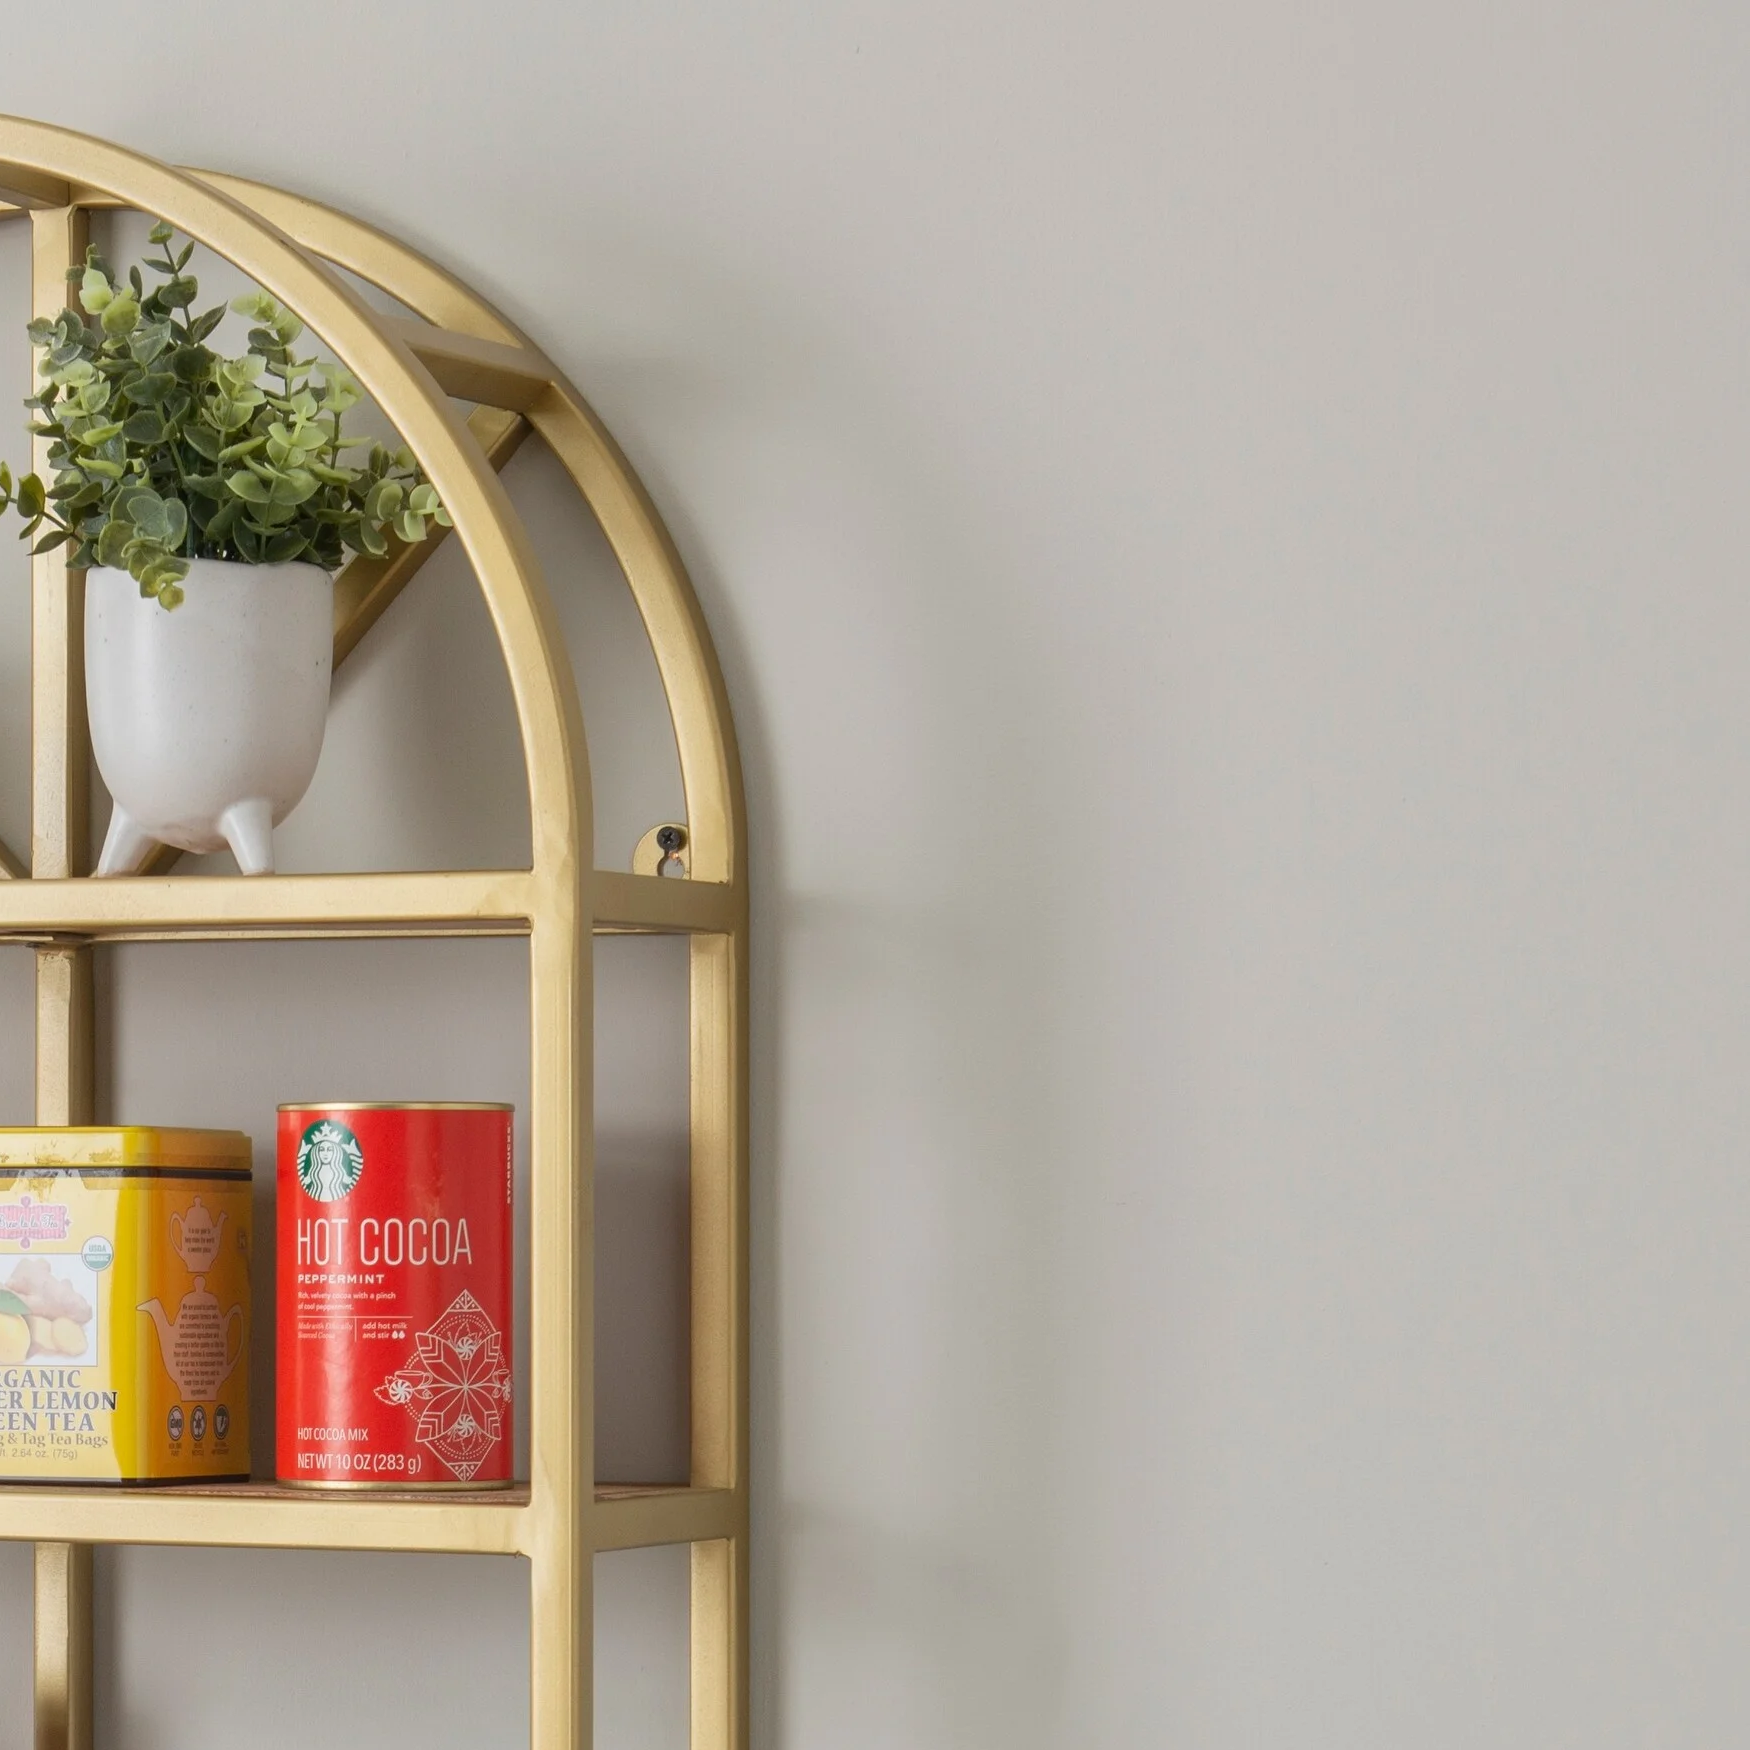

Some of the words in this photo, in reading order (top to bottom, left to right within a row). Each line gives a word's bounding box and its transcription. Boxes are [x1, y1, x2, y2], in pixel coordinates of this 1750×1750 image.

[297, 1217, 348, 1265] HOT
[360, 1217, 472, 1266] COCOA
[297, 1273, 385, 1285] PEPPERMINT
[353, 1291, 369, 1299] with
[375, 1291, 396, 1301] pinch
[362, 1322, 375, 1330] add
[377, 1322, 391, 1330] hot
[391, 1322, 407, 1330] milk
[362, 1331, 376, 1339] and
[377, 1331, 390, 1339] stir
[32, 1391, 118, 1411] LEMON
[45, 1413, 94, 1432] TEA
[7, 1432, 18, 1445] &
[21, 1432, 46, 1448] Tag
[48, 1433, 72, 1445] Tea
[76, 1434, 108, 1448] Bags
[297, 1427, 313, 1440] HOT
[313, 1427, 346, 1441] COCOA
[347, 1428, 369, 1441] MIX
[11, 1448, 32, 1458] 2.64
[52, 1448, 78, 1460] (75g)
[297, 1453, 314, 1469] NET
[315, 1453, 333, 1469] WT
[335, 1454, 351, 1470] 10
[353, 1454, 371, 1470] OZ
[373, 1454, 405, 1473] (283
[407, 1454, 422, 1475] g)
